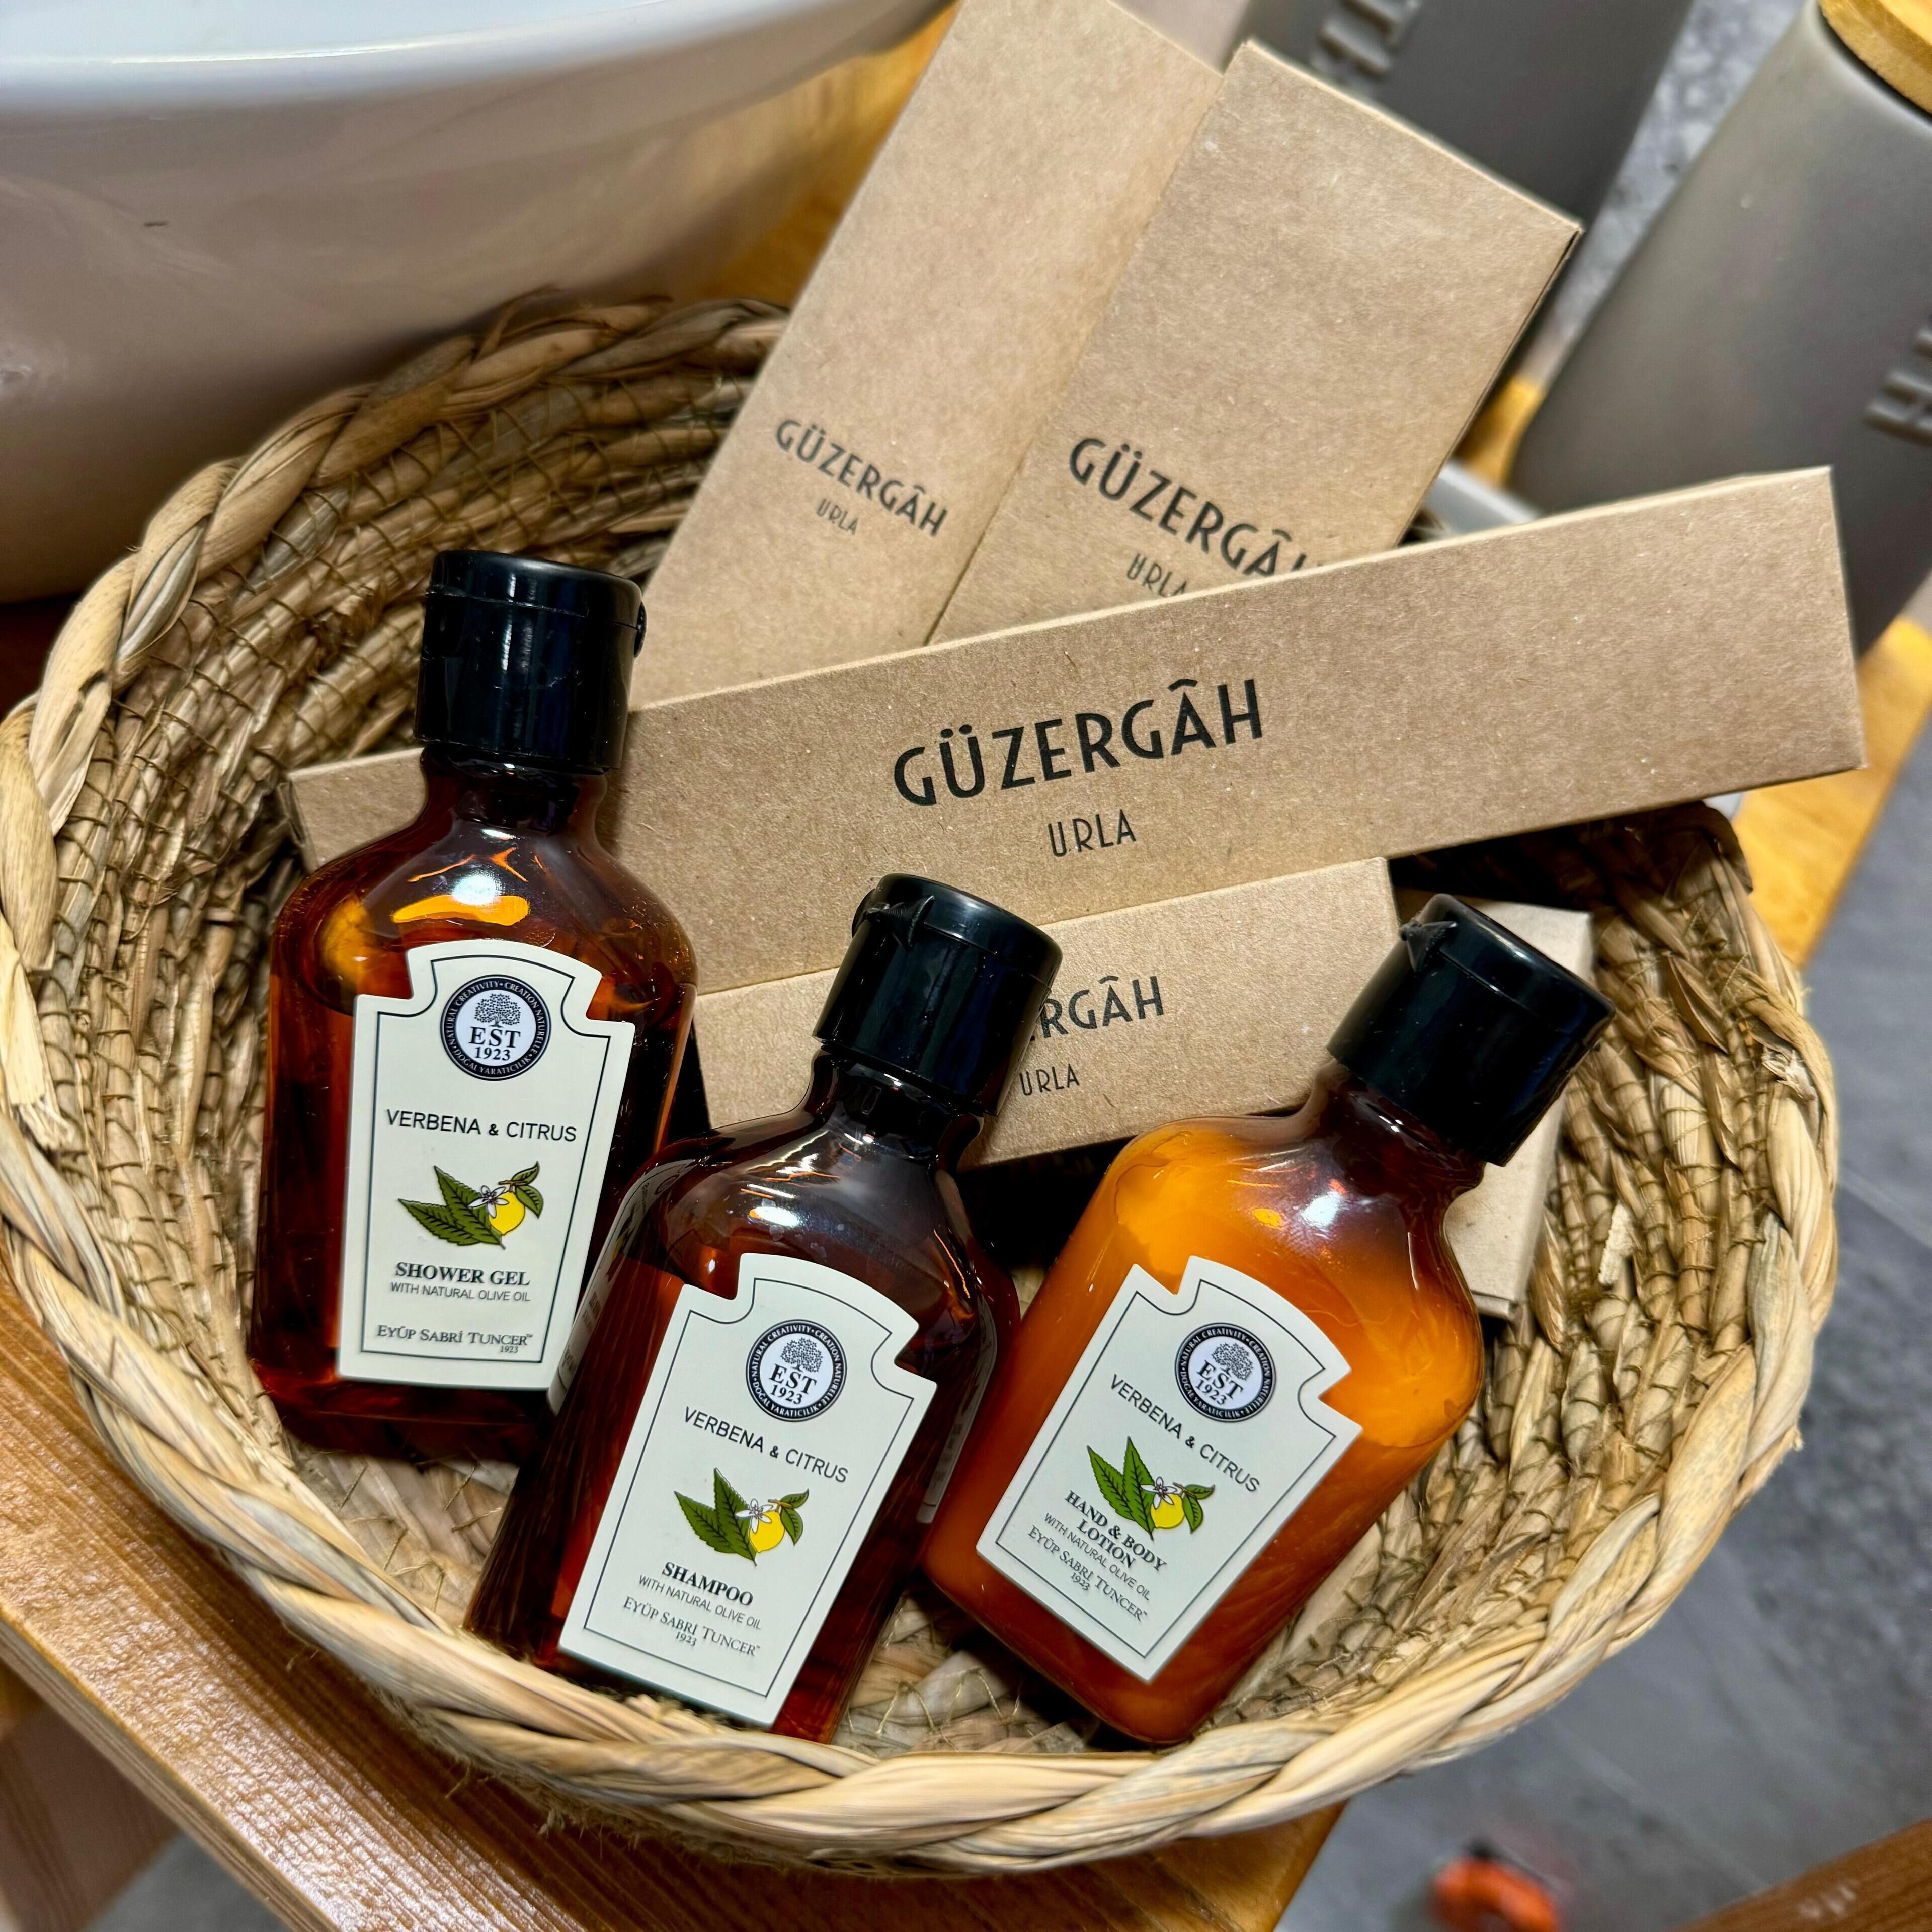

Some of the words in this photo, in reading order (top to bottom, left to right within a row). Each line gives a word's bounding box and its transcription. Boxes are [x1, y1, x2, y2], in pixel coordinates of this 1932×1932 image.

[776, 420, 948, 537] GÜZERGÂH
[817, 499, 858, 535] URLA
[1069, 438, 1307, 578] GÜZERGÂ
[894, 679, 1262, 806] GÜZERGÂH
[1048, 809, 1136, 856] URLA
[445, 1008, 456, 1045] NATURAL
[455, 981, 500, 1006] CREATIVITY
[505, 982, 539, 1008] CREATION
[530, 1010, 545, 1055] NATURELLE
[1030, 975, 1164, 1041] RGÂH
[468, 1026, 521, 1048] EST
[474, 1046, 511, 1061] 1923
[1019, 1063, 1080, 1096] URLA
[386, 1109, 481, 1135] VERBENA
[488, 1123, 499, 1136] &
[506, 1121, 577, 1142] CITRUS
[390, 1281, 419, 1295] WITH
[422, 1285, 475, 1299] NATURAL
[478, 1289, 510, 1301] OLIVE
[513, 1291, 531, 1302] OIL
[395, 1261, 486, 1284] SHOWER
[490, 1270, 531, 1286] GEL
[499, 1345, 519, 1354] 1923
[751, 1341, 769, 1377] NATURAL
[768, 1324, 812, 1342] CREATIVITY
[815, 1330, 841, 1361] CREATION
[1180, 1336, 1201, 1370] NATURAL
[1202, 1328, 1248, 1342] CREATIVITY
[768, 1363, 817, 1395] EST
[770, 1384, 803, 1405] 1923
[822, 1363, 842, 1405] NATURELLE
[1195, 1379, 1227, 1405] 1923
[1196, 1359, 1244, 1399] EST
[685, 1406, 763, 1453] VERBENA
[769, 1445, 779, 1458] &
[785, 1448, 849, 1483] CITRUS
[1110, 1373, 1182, 1439] VERBENA
[1184, 1436, 1195, 1448] &
[1199, 1443, 1260, 1492] CITRUS
[1064, 1490, 1108, 1527] HAND
[1108, 1525, 1122, 1540] &
[1121, 1534, 1167, 1572] BODY
[1076, 1518, 1137, 1569] LOTION
[1044, 1512, 1069, 1536] WITH
[1067, 1531, 1107, 1568] NATURAL
[1109, 1564, 1138, 1588] OLIVE
[1136, 1584, 1150, 1601] OIL
[639, 1574, 665, 1593] WITH
[666, 1586, 712, 1612] NATURAL
[715, 1605, 746, 1623] OLIVE
[746, 1616, 761, 1630] OIL
[662, 1561, 754, 1606] SHAMPOO
[1071, 1572, 1091, 1591] 1923
[623, 1596, 659, 1619] EYÜP
[675, 1632, 698, 1646] 1923
